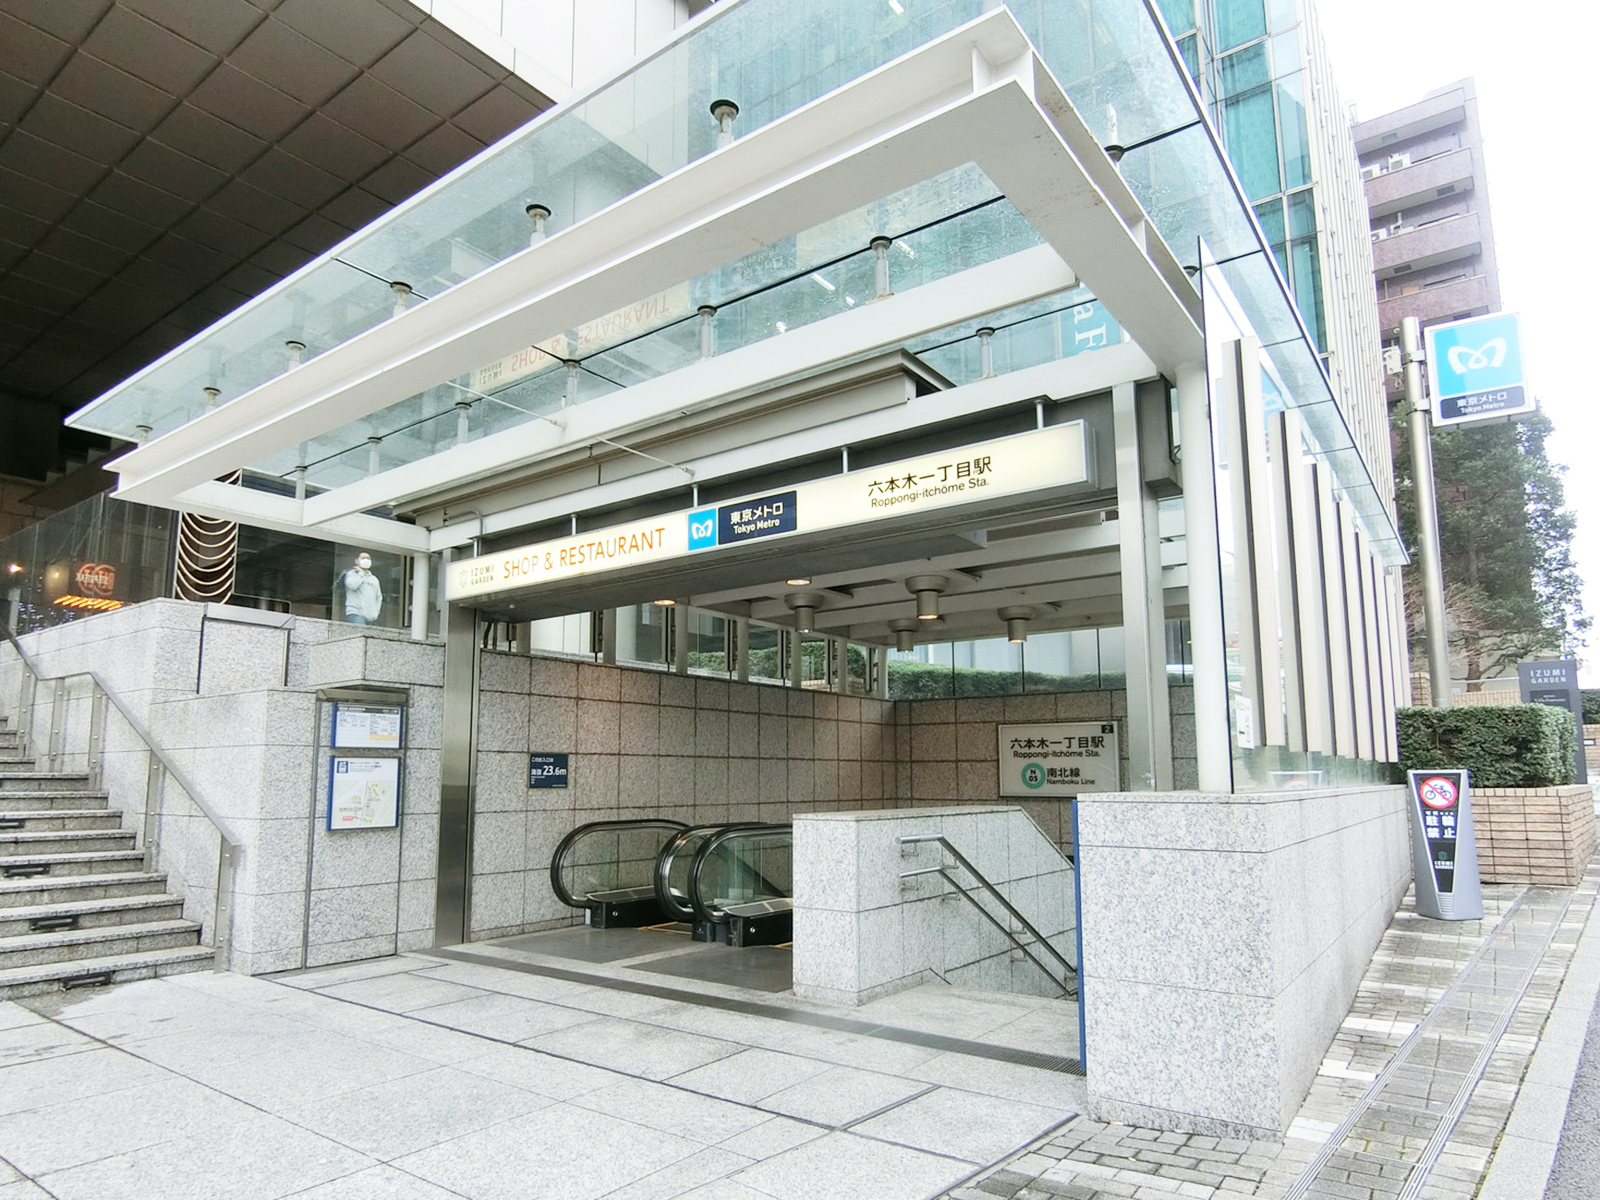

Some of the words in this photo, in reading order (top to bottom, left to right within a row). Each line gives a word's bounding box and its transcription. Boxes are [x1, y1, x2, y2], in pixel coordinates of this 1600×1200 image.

[1457, 392, 1507, 407] 東京メトロ
[868, 456, 992, 497] 六本木一丁目駅
[968, 477, 989, 489] Sta.
[730, 502, 783, 525] 東京メトロ
[733, 523, 756, 535] Tokyo
[756, 518, 780, 530] Metro
[503, 556, 539, 579] SHOP
[544, 551, 554, 571] &
[560, 527, 666, 567] RESTAURANT
[471, 564, 494, 577] IZUMI
[471, 575, 494, 586] GARDEN
[1530, 669, 1565, 677] IZUMI
[1104, 725, 1110, 733] 2
[1010, 736, 1105, 750] 六本木一丁目駅
[1085, 749, 1101, 758] Sta.
[1046, 767, 1081, 778] 南北線
